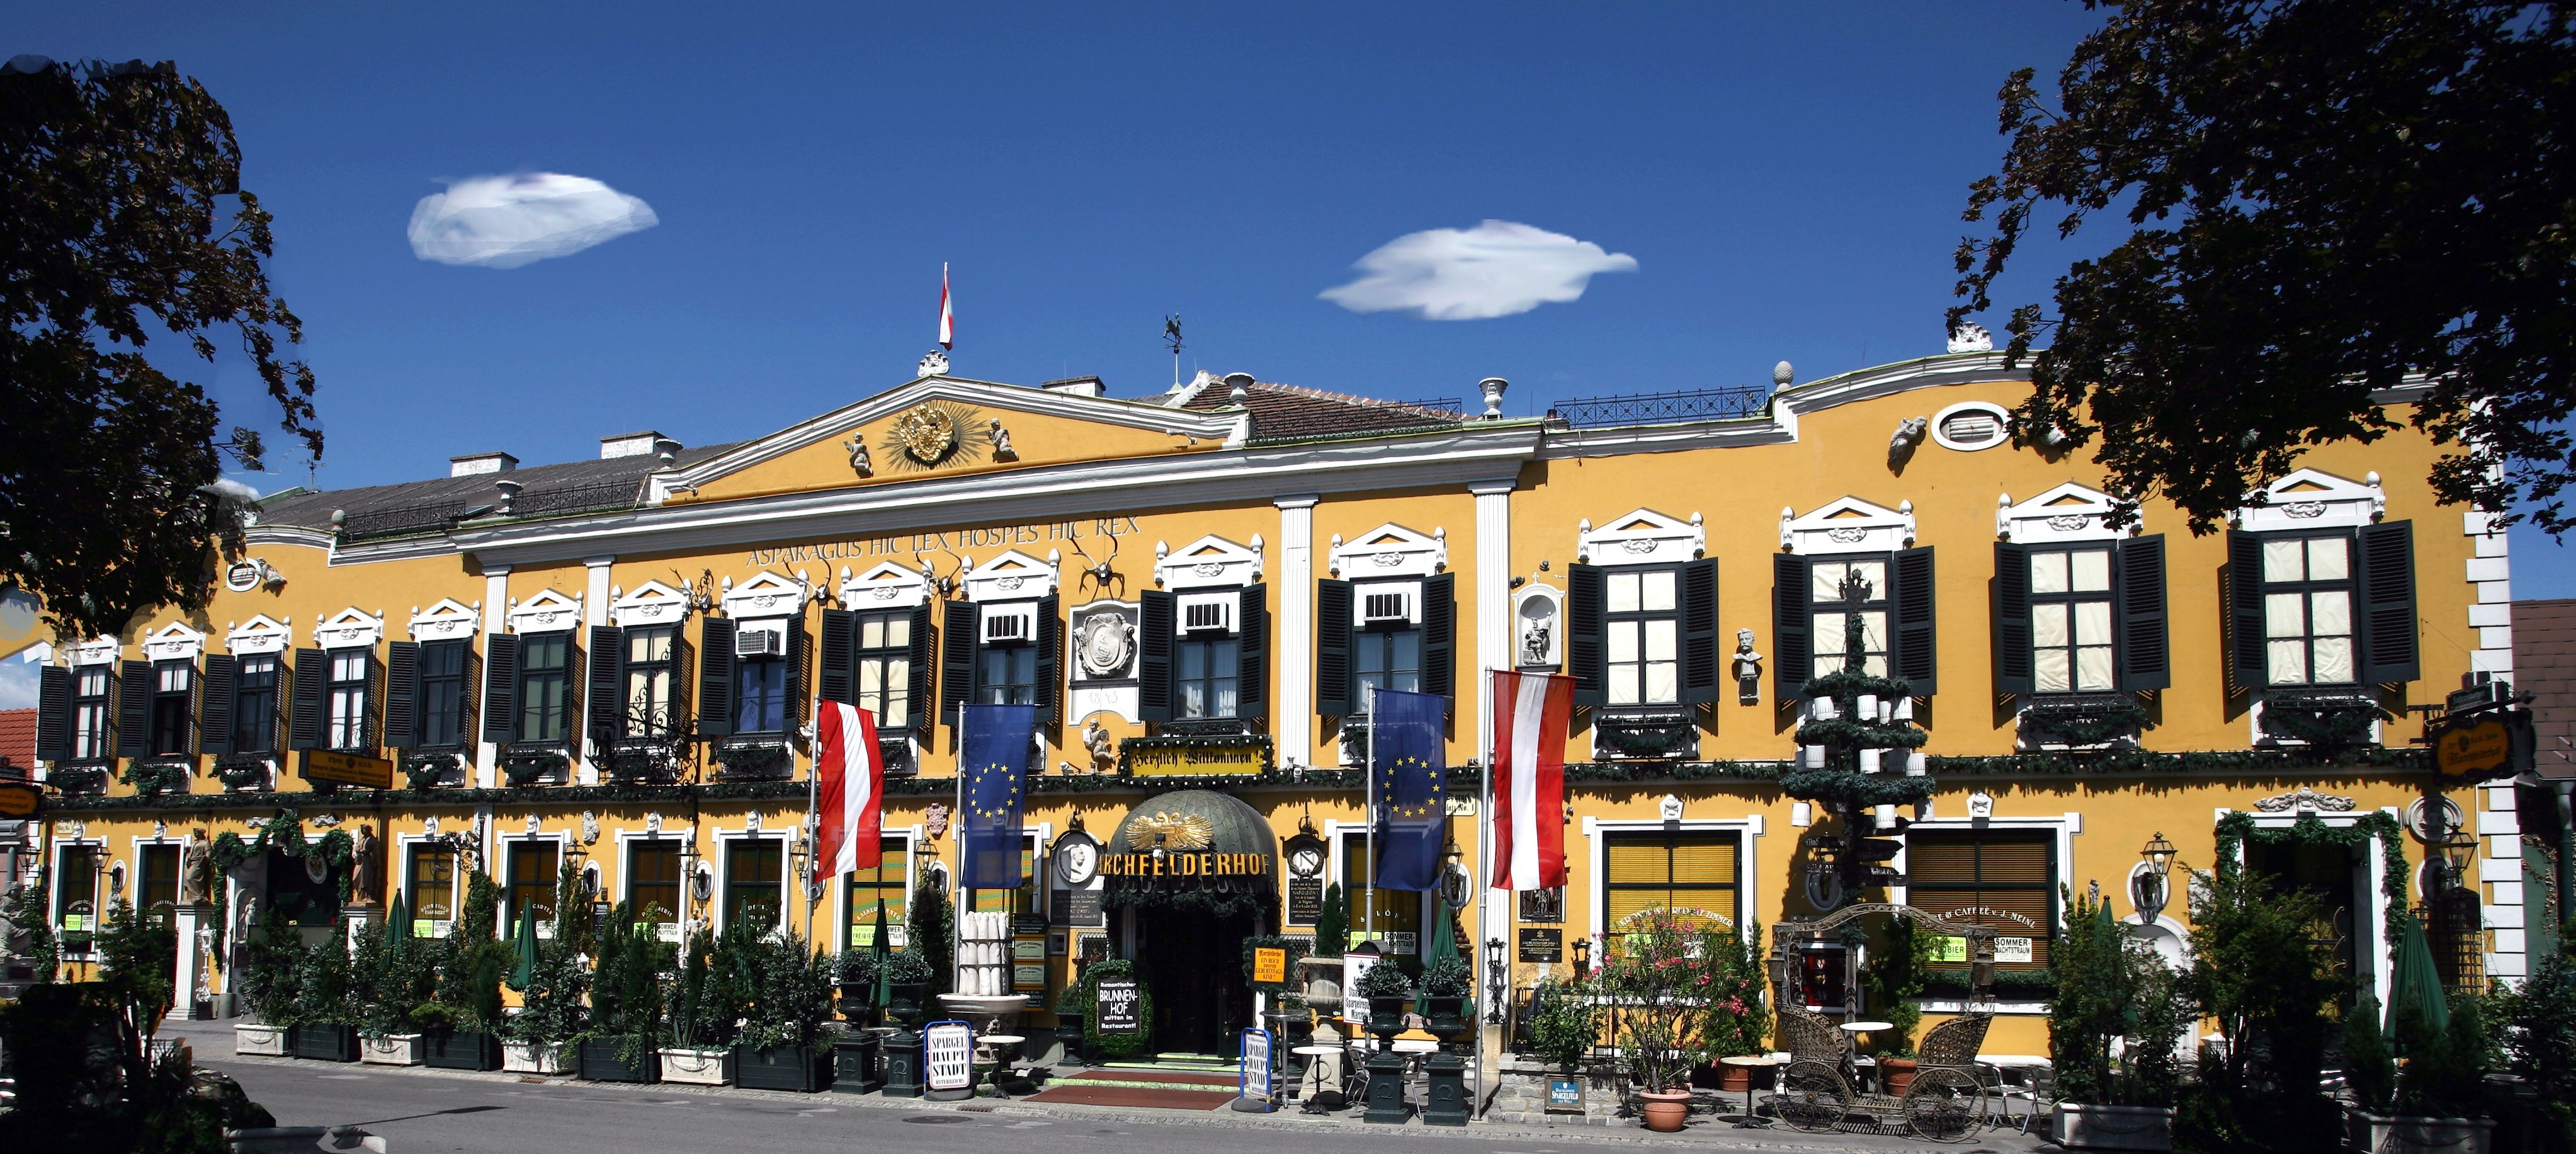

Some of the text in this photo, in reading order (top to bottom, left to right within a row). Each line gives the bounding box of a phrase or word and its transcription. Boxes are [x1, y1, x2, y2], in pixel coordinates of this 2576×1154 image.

[746, 539, 863, 567] ASPARAGUS
[870, 535, 905, 556] HIC
[959, 524, 1038, 549] HOSPES
[1050, 520, 1086, 541] HIC
[1098, 853, 1269, 876] ARCHFELDERHOF
[2010, 912, 2036, 929] MEINL
[1995, 937, 2031, 947] SOMMER-
[1099, 989, 1138, 1002] BRUNNEN-
[1110, 1002, 1128, 1015] HOF
[932, 1036, 966, 1049] SPARGEL
[933, 1050, 967, 1062] HAUPT
[933, 1063, 967, 1077] STADT
[1250, 1071, 1267, 1085] STAD
